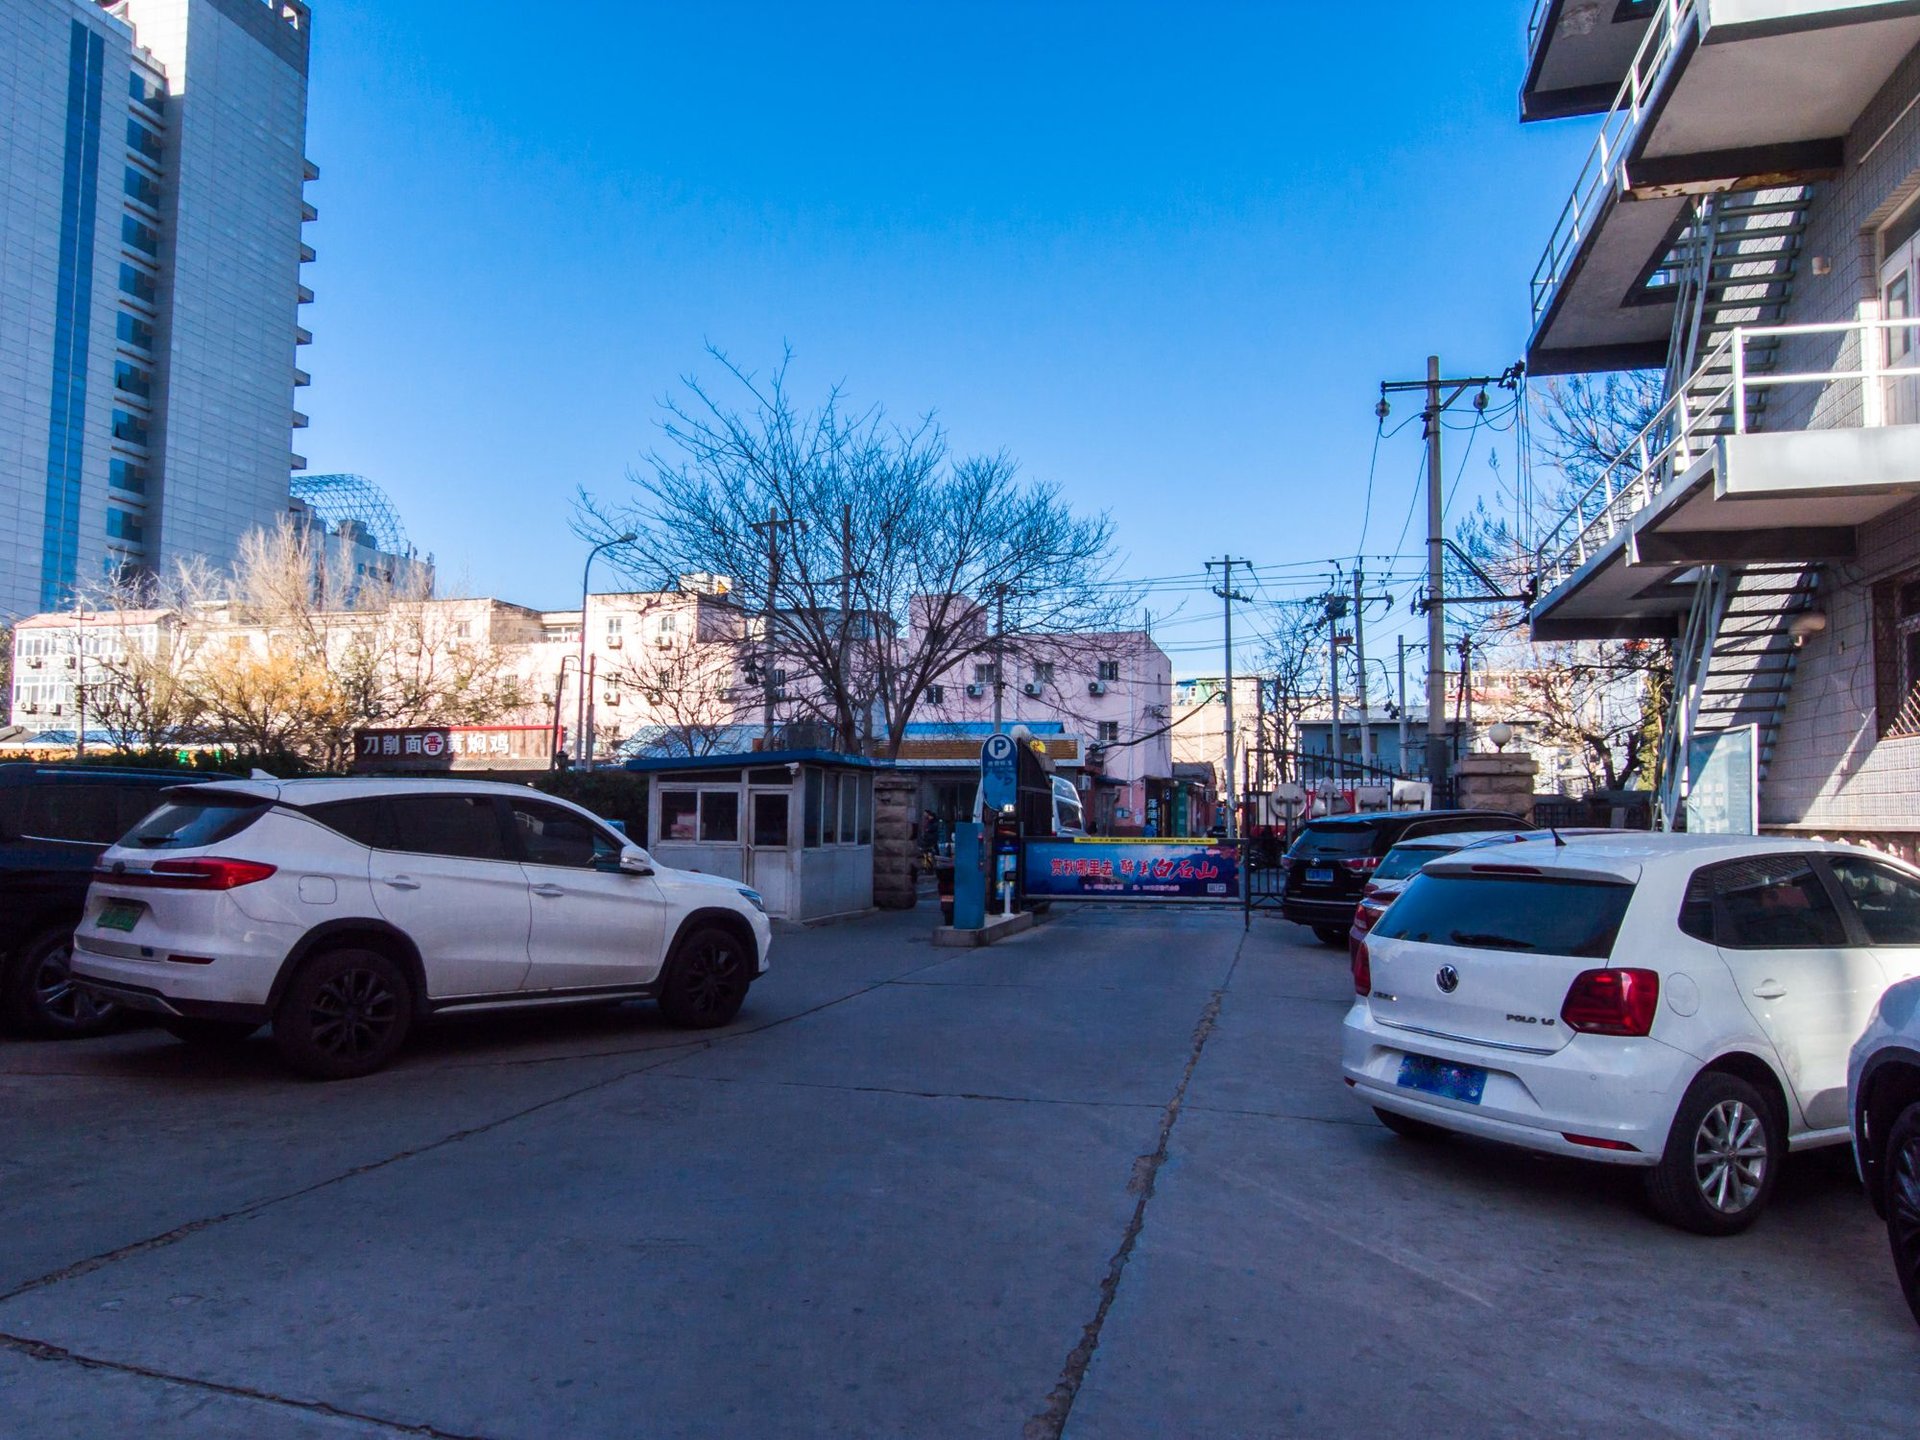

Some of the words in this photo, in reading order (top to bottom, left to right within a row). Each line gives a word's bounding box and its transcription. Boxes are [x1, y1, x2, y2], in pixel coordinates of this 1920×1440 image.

[363, 735, 421, 755] 刀削面
[446, 733, 510, 754] 黄焖鸡
[994, 739, 1007, 756] P
[1051, 858, 1113, 876] 赏秋哪里去
[1506, 1014, 1537, 1024] POLO
